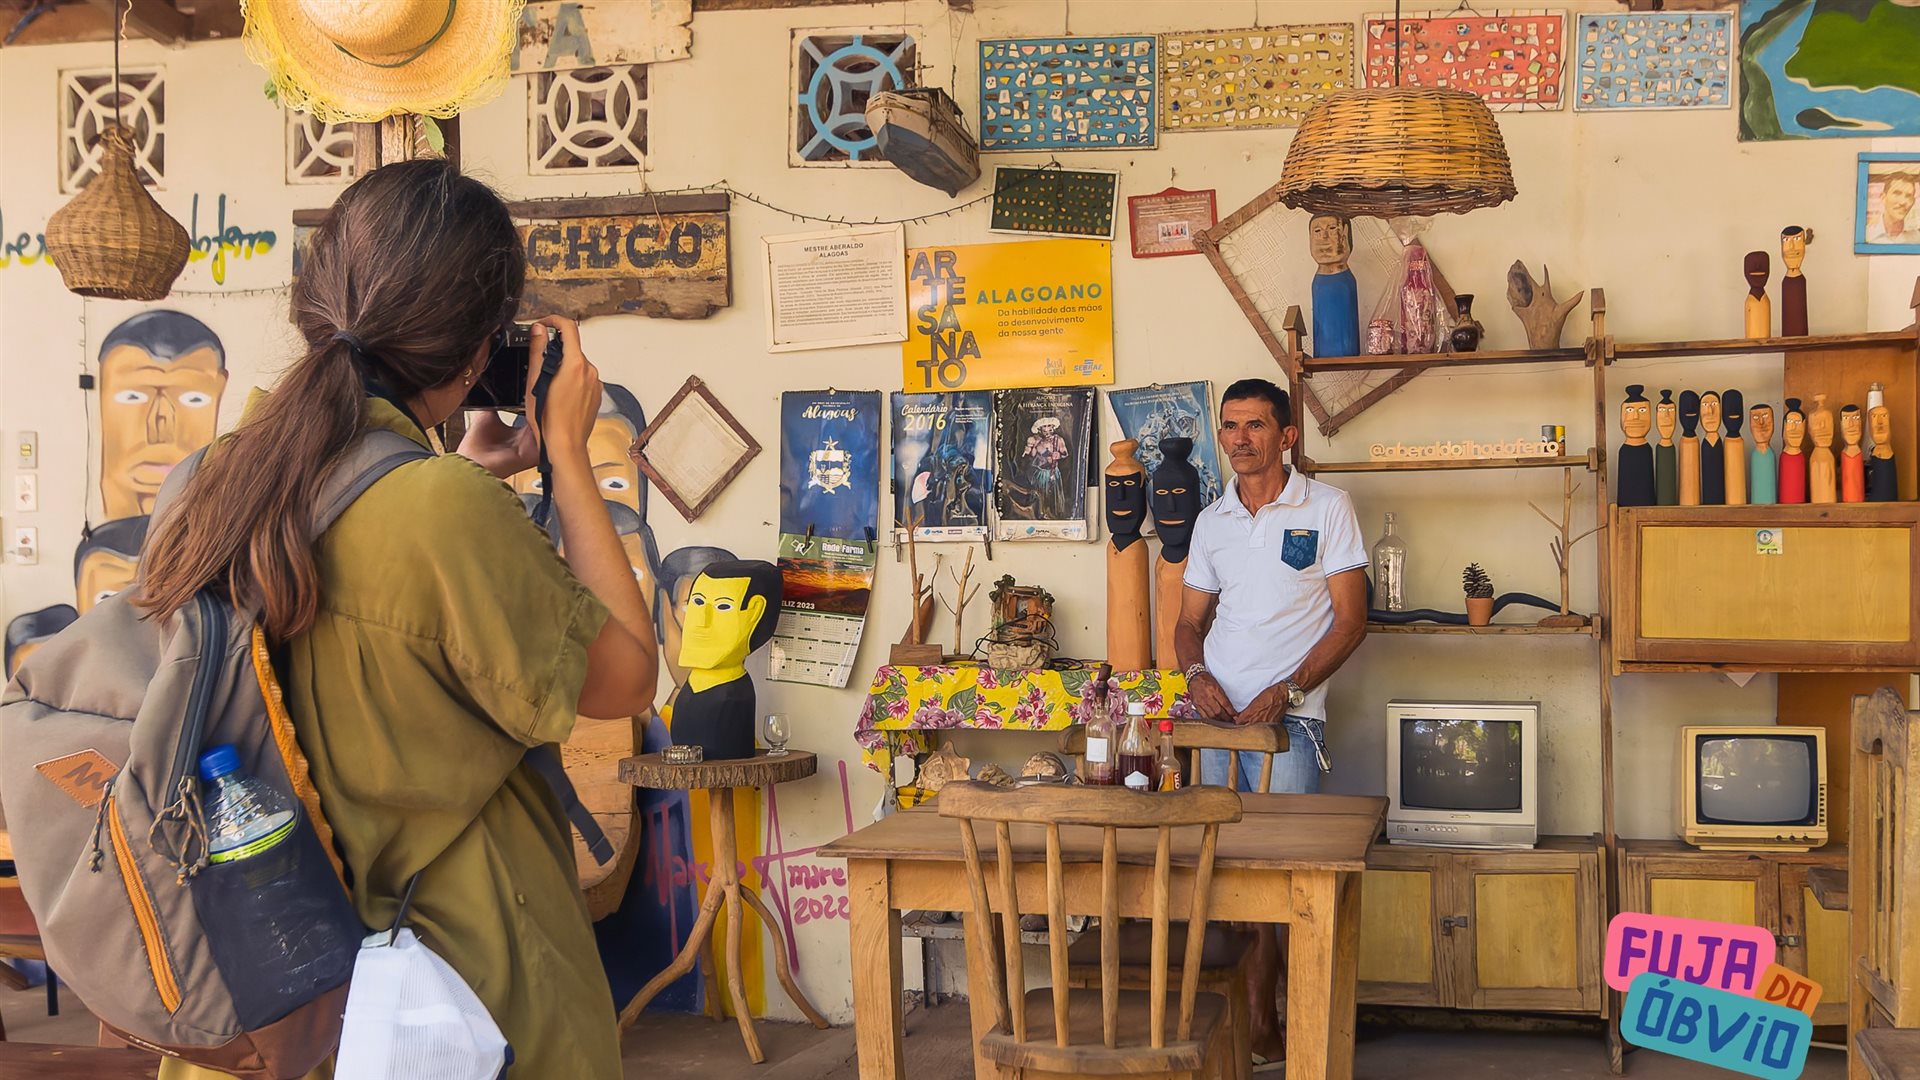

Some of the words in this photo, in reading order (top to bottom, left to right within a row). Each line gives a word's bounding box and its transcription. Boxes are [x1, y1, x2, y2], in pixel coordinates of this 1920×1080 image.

[527, 222, 701, 270] CHICO
[804, 244, 828, 253] MESTRE
[829, 242, 864, 252] ABERALDO
[976, 283, 1103, 305] ALAGOANO
[997, 309, 1010, 317] Da
[1011, 306, 1058, 316] habilidade
[1059, 305, 1077, 314] das
[1078, 304, 1103, 313] mãos
[1010, 316, 1085, 327] desenvolvimento
[998, 329, 1010, 338] da
[1011, 328, 1037, 337] nossa
[802, 405, 858, 422] Alagoas
[901, 403, 948, 416] Calendário
[903, 413, 947, 431] 2016
[822, 542, 840, 553] Rede
[841, 544, 864, 555] Farma
[781, 600, 796, 608] ELIZ
[796, 601, 815, 610] 2023
[794, 895, 850, 925] 2022
